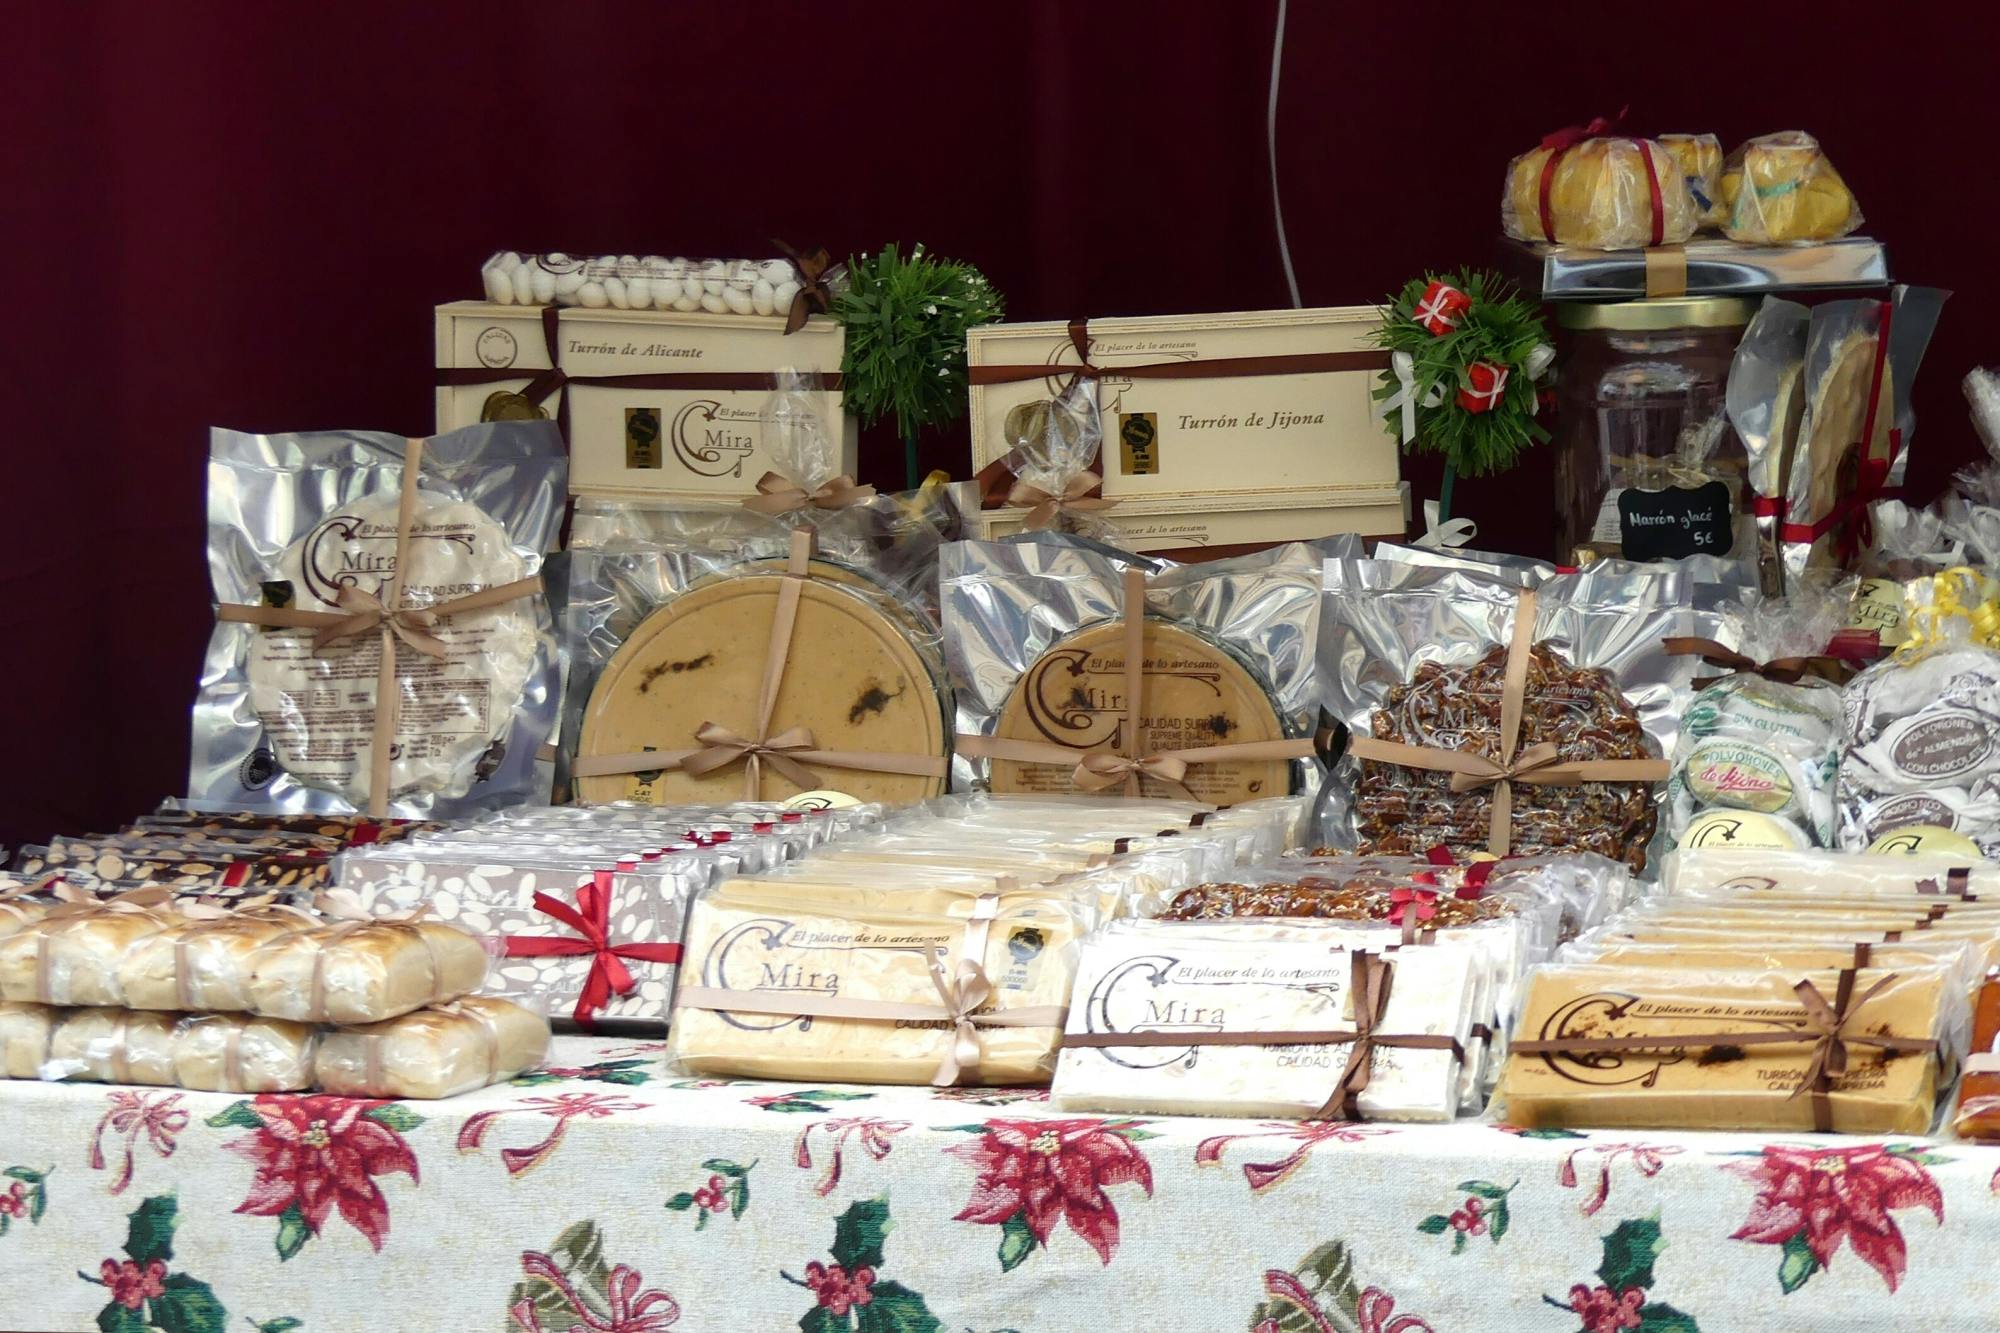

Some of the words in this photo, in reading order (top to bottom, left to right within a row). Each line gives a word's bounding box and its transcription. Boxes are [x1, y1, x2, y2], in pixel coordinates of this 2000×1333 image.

[568, 340, 616, 355] Turrón
[620, 342, 637, 356] de
[640, 344, 703, 359] Alicante
[1095, 344, 1104, 352] El
[1106, 343, 1134, 353] placer
[1136, 340, 1146, 350] de
[1159, 341, 1197, 349] artesano
[719, 408, 729, 416] El
[731, 409, 757, 418] placer
[1178, 414, 1238, 430] Turrón
[1244, 412, 1264, 427] de
[1267, 411, 1325, 430] Jijona
[704, 429, 753, 448] Mira
[1680, 506, 1713, 529] glacé
[361, 524, 371, 533] El
[372, 524, 399, 535] place
[1146, 525, 1157, 533] de
[1159, 525, 1168, 533] lo
[1693, 531, 1714, 546] 5€
[340, 551, 397, 570] Mira
[1091, 658, 1102, 668] El
[1157, 658, 1168, 668] lo
[1171, 659, 1220, 669] artesano
[1905, 718, 1975, 746] POLVORONES
[1923, 733, 1981, 753] ALMENDRA
[1906, 761, 1927, 774] CON
[1928, 744, 1987, 774] CHOCOLATE
[791, 931, 804, 942] El
[806, 932, 851, 944] placer
[854, 933, 870, 943] de
[874, 934, 887, 943] lo
[758, 963, 840, 988] Mira
[1178, 967, 1191, 978] El
[1193, 967, 1236, 980] placer
[1241, 967, 1258, 978] de
[1262, 967, 1274, 978] lo
[1279, 968, 1340, 979] artesano
[1141, 1000, 1226, 1025] Mira
[1636, 1003, 1651, 1013] El
[1653, 1004, 1701, 1016] placer
[1704, 1006, 1723, 1015] de
[1727, 1007, 1739, 1016] lo
[1743, 1008, 1810, 1017] artesano
[1276, 1055, 1332, 1068] CALIDAD
